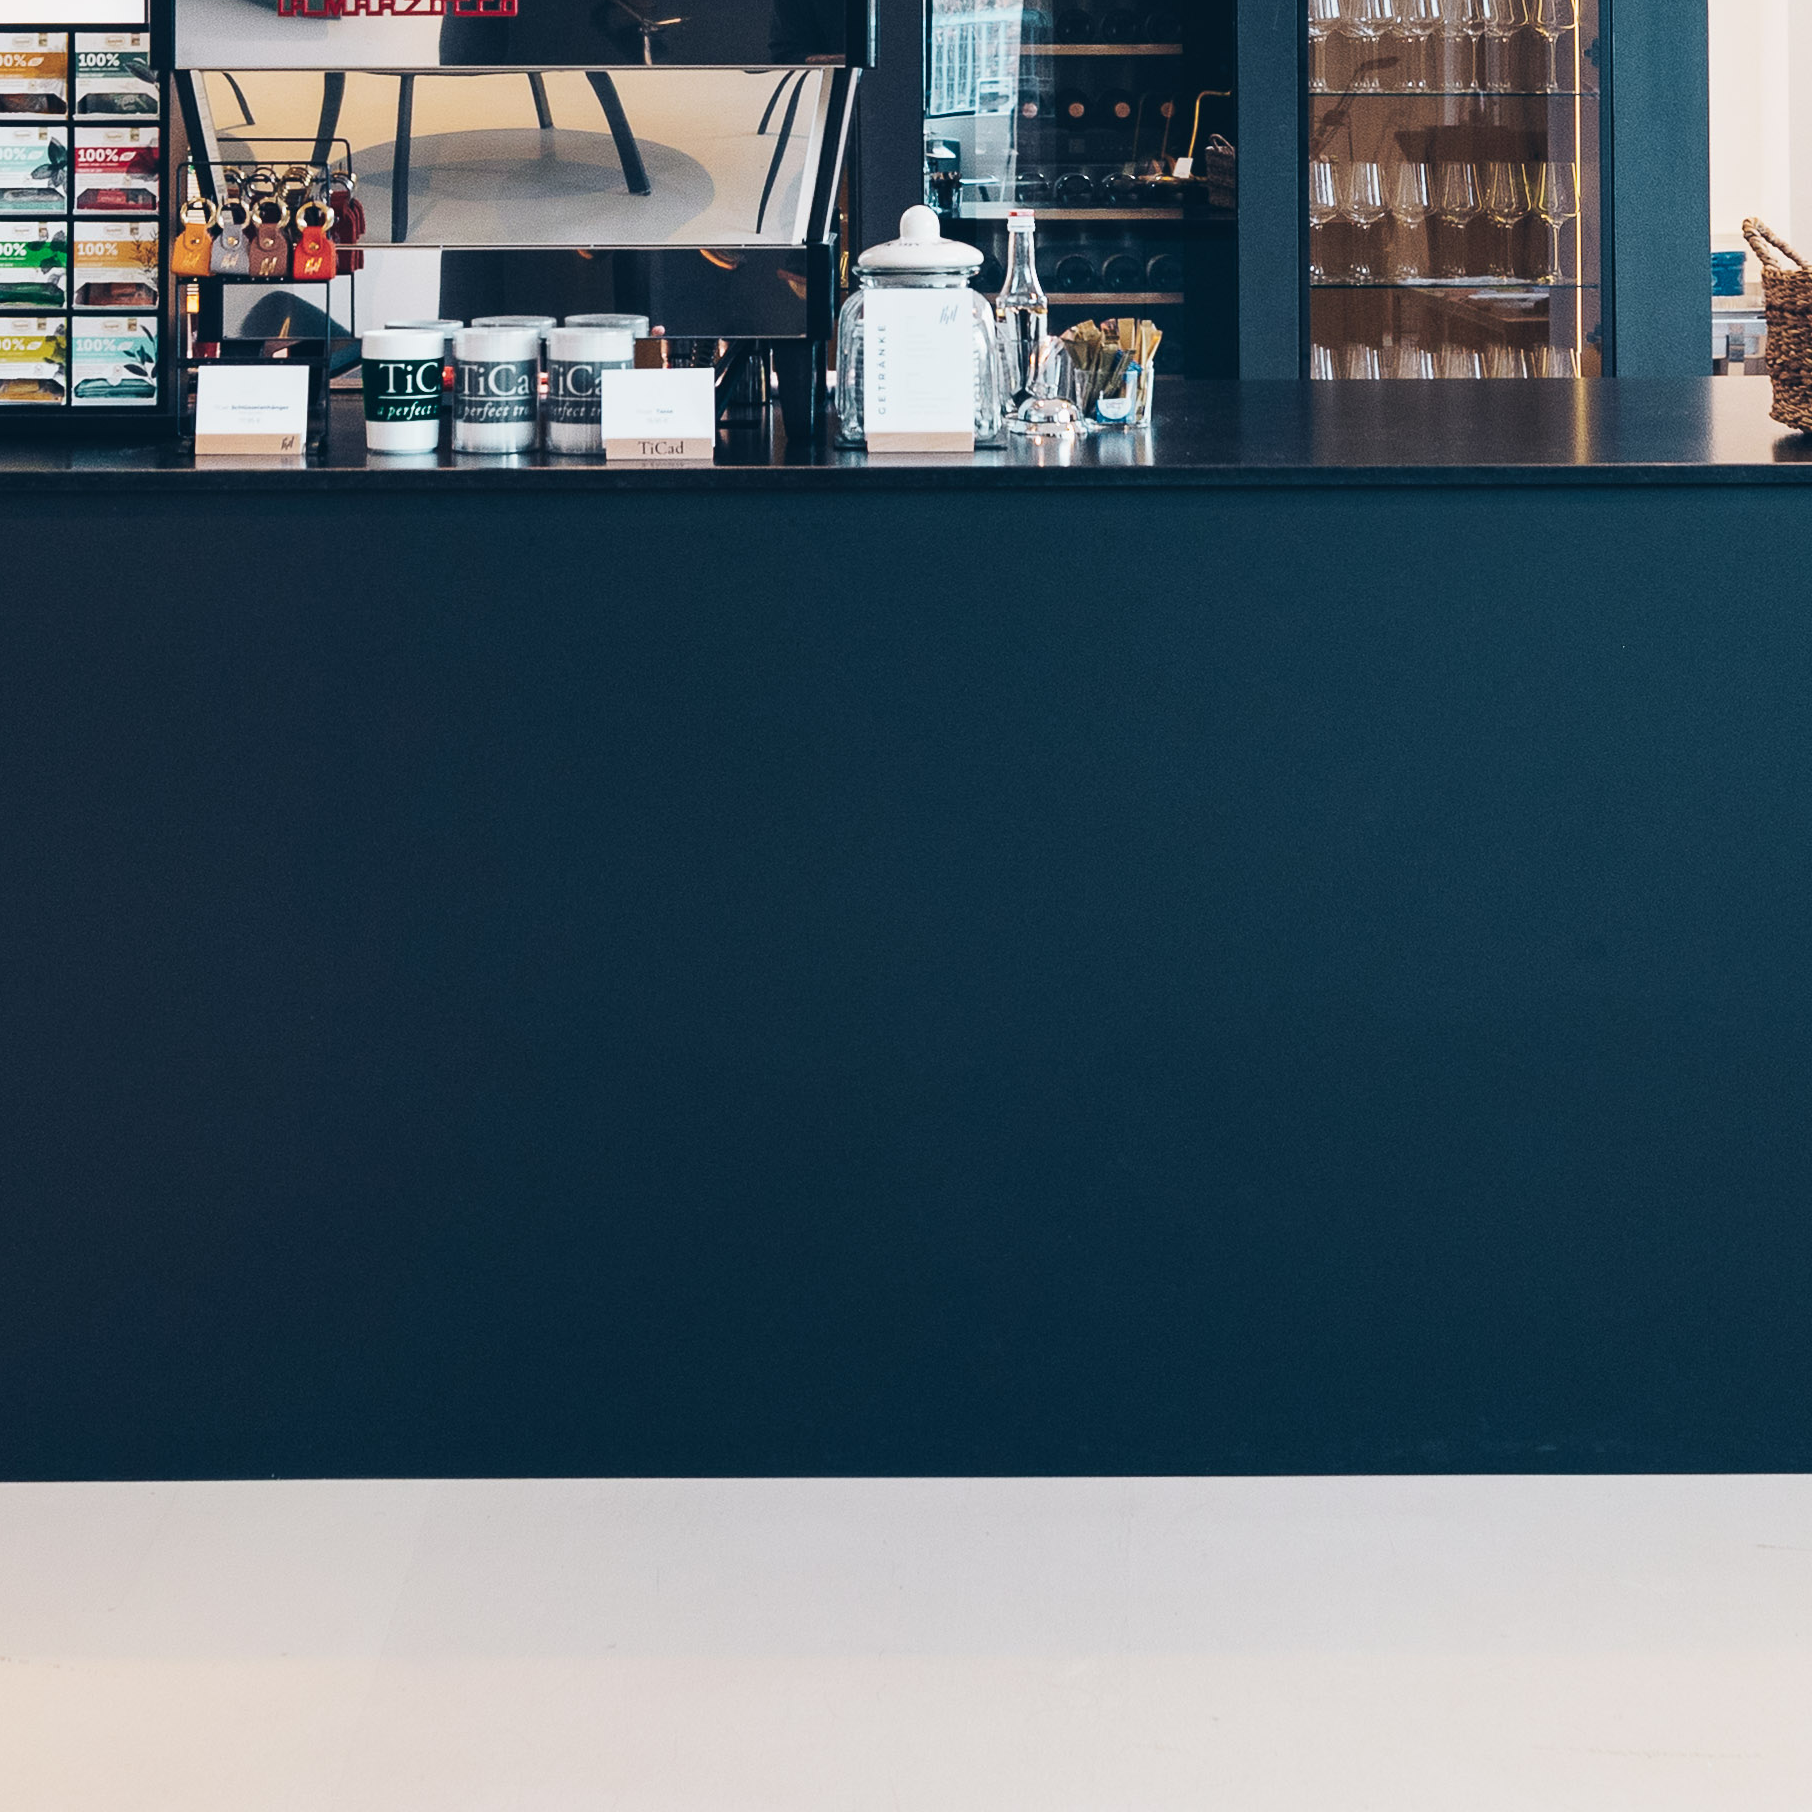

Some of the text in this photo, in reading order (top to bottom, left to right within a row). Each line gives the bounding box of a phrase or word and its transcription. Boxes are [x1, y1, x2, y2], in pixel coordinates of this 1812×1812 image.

[78, 53, 120, 67] 100%
[78, 148, 119, 162] 100%
[77, 243, 118, 256] 100%
[75, 338, 117, 352] 100%
[379, 362, 440, 394] TiC
[459, 364, 535, 396] TiCa
[387, 400, 432, 421] perfect
[462, 401, 509, 422] perfect
[638, 440, 684, 455] TiCad
